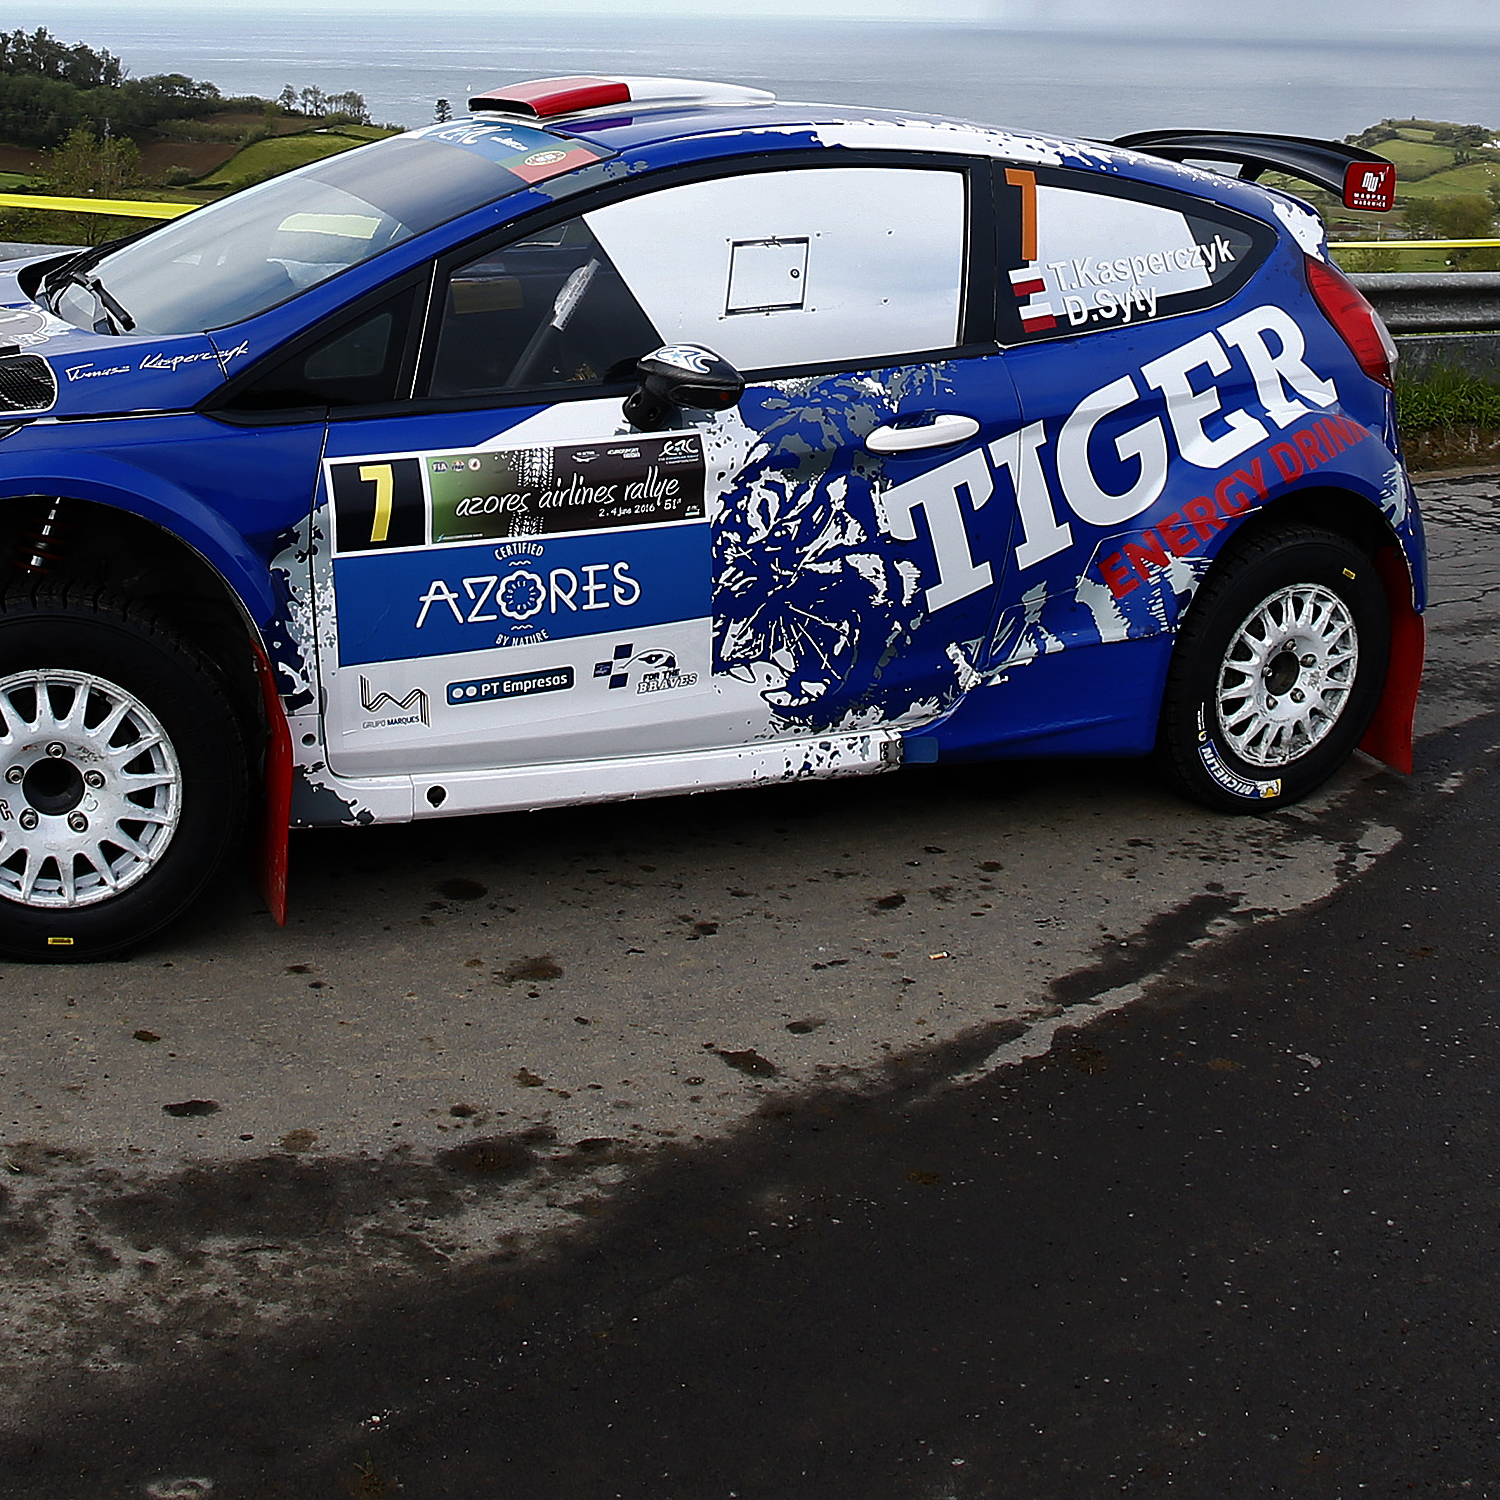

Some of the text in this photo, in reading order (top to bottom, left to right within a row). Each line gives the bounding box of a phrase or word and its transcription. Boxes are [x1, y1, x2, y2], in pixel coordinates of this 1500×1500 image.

[1046, 234, 1236, 292] T.Kasperczyk
[1063, 284, 1157, 327] D.Syty
[880, 305, 1339, 614] TIGER
[359, 463, 394, 542] 7
[455, 465, 681, 517] azores airlines rallye
[634, 503, 656, 514] 2016
[1097, 457, 1272, 599] ENERGY
[494, 542, 544, 561] CERTIFIED
[415, 561, 641, 629] AZORES
[495, 628, 550, 647] BY NATURE
[481, 681, 500, 696] PT
[637, 673, 698, 695] BRAVES
[643, 668, 681, 682] FOR THE
[362, 715, 420, 729] GRUPO MARQUES
[1201, 746, 1255, 795] MICHELIN
